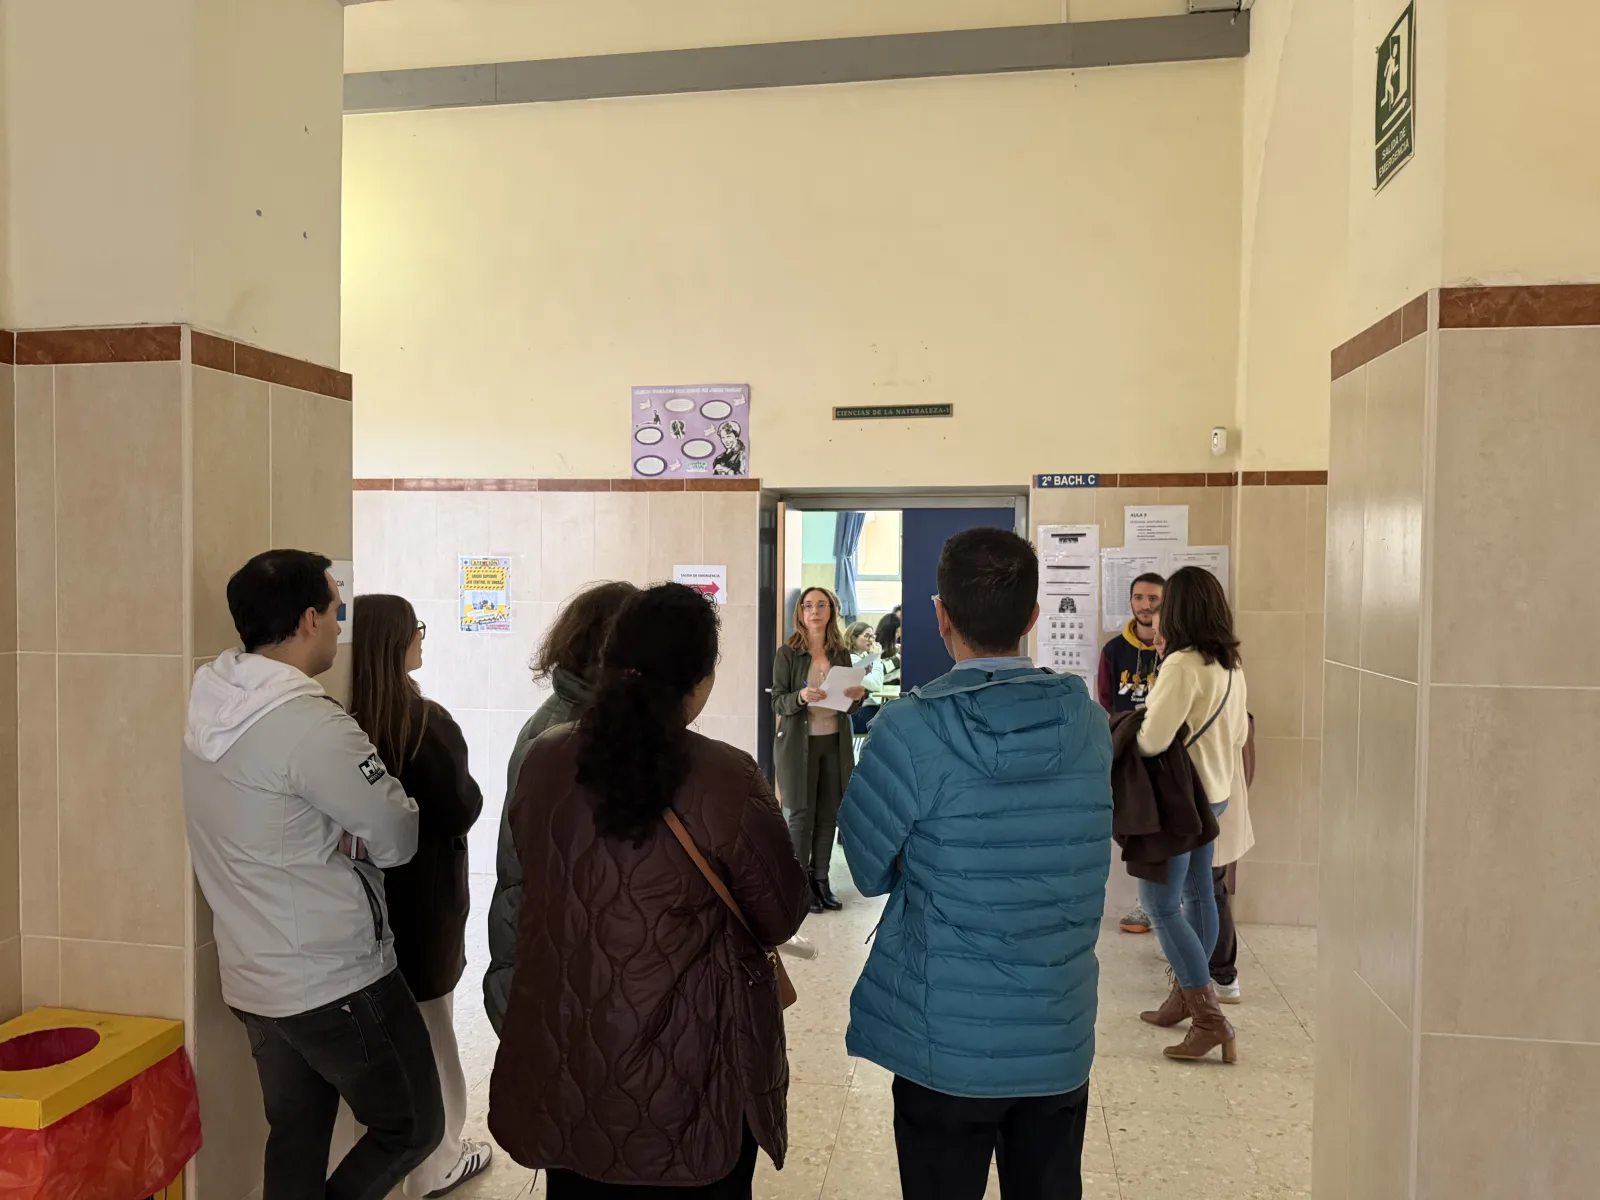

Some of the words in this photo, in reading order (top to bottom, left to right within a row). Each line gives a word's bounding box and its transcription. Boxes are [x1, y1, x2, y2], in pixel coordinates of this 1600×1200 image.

[1382, 136, 1398, 160] SALIDA
[1399, 126, 1406, 141] DE
[1379, 138, 1409, 178] EMERGENCIA
[836, 409, 870, 417] CIENCIAS
[1054, 475, 1085, 486] BACH.
[1087, 474, 1096, 485] C
